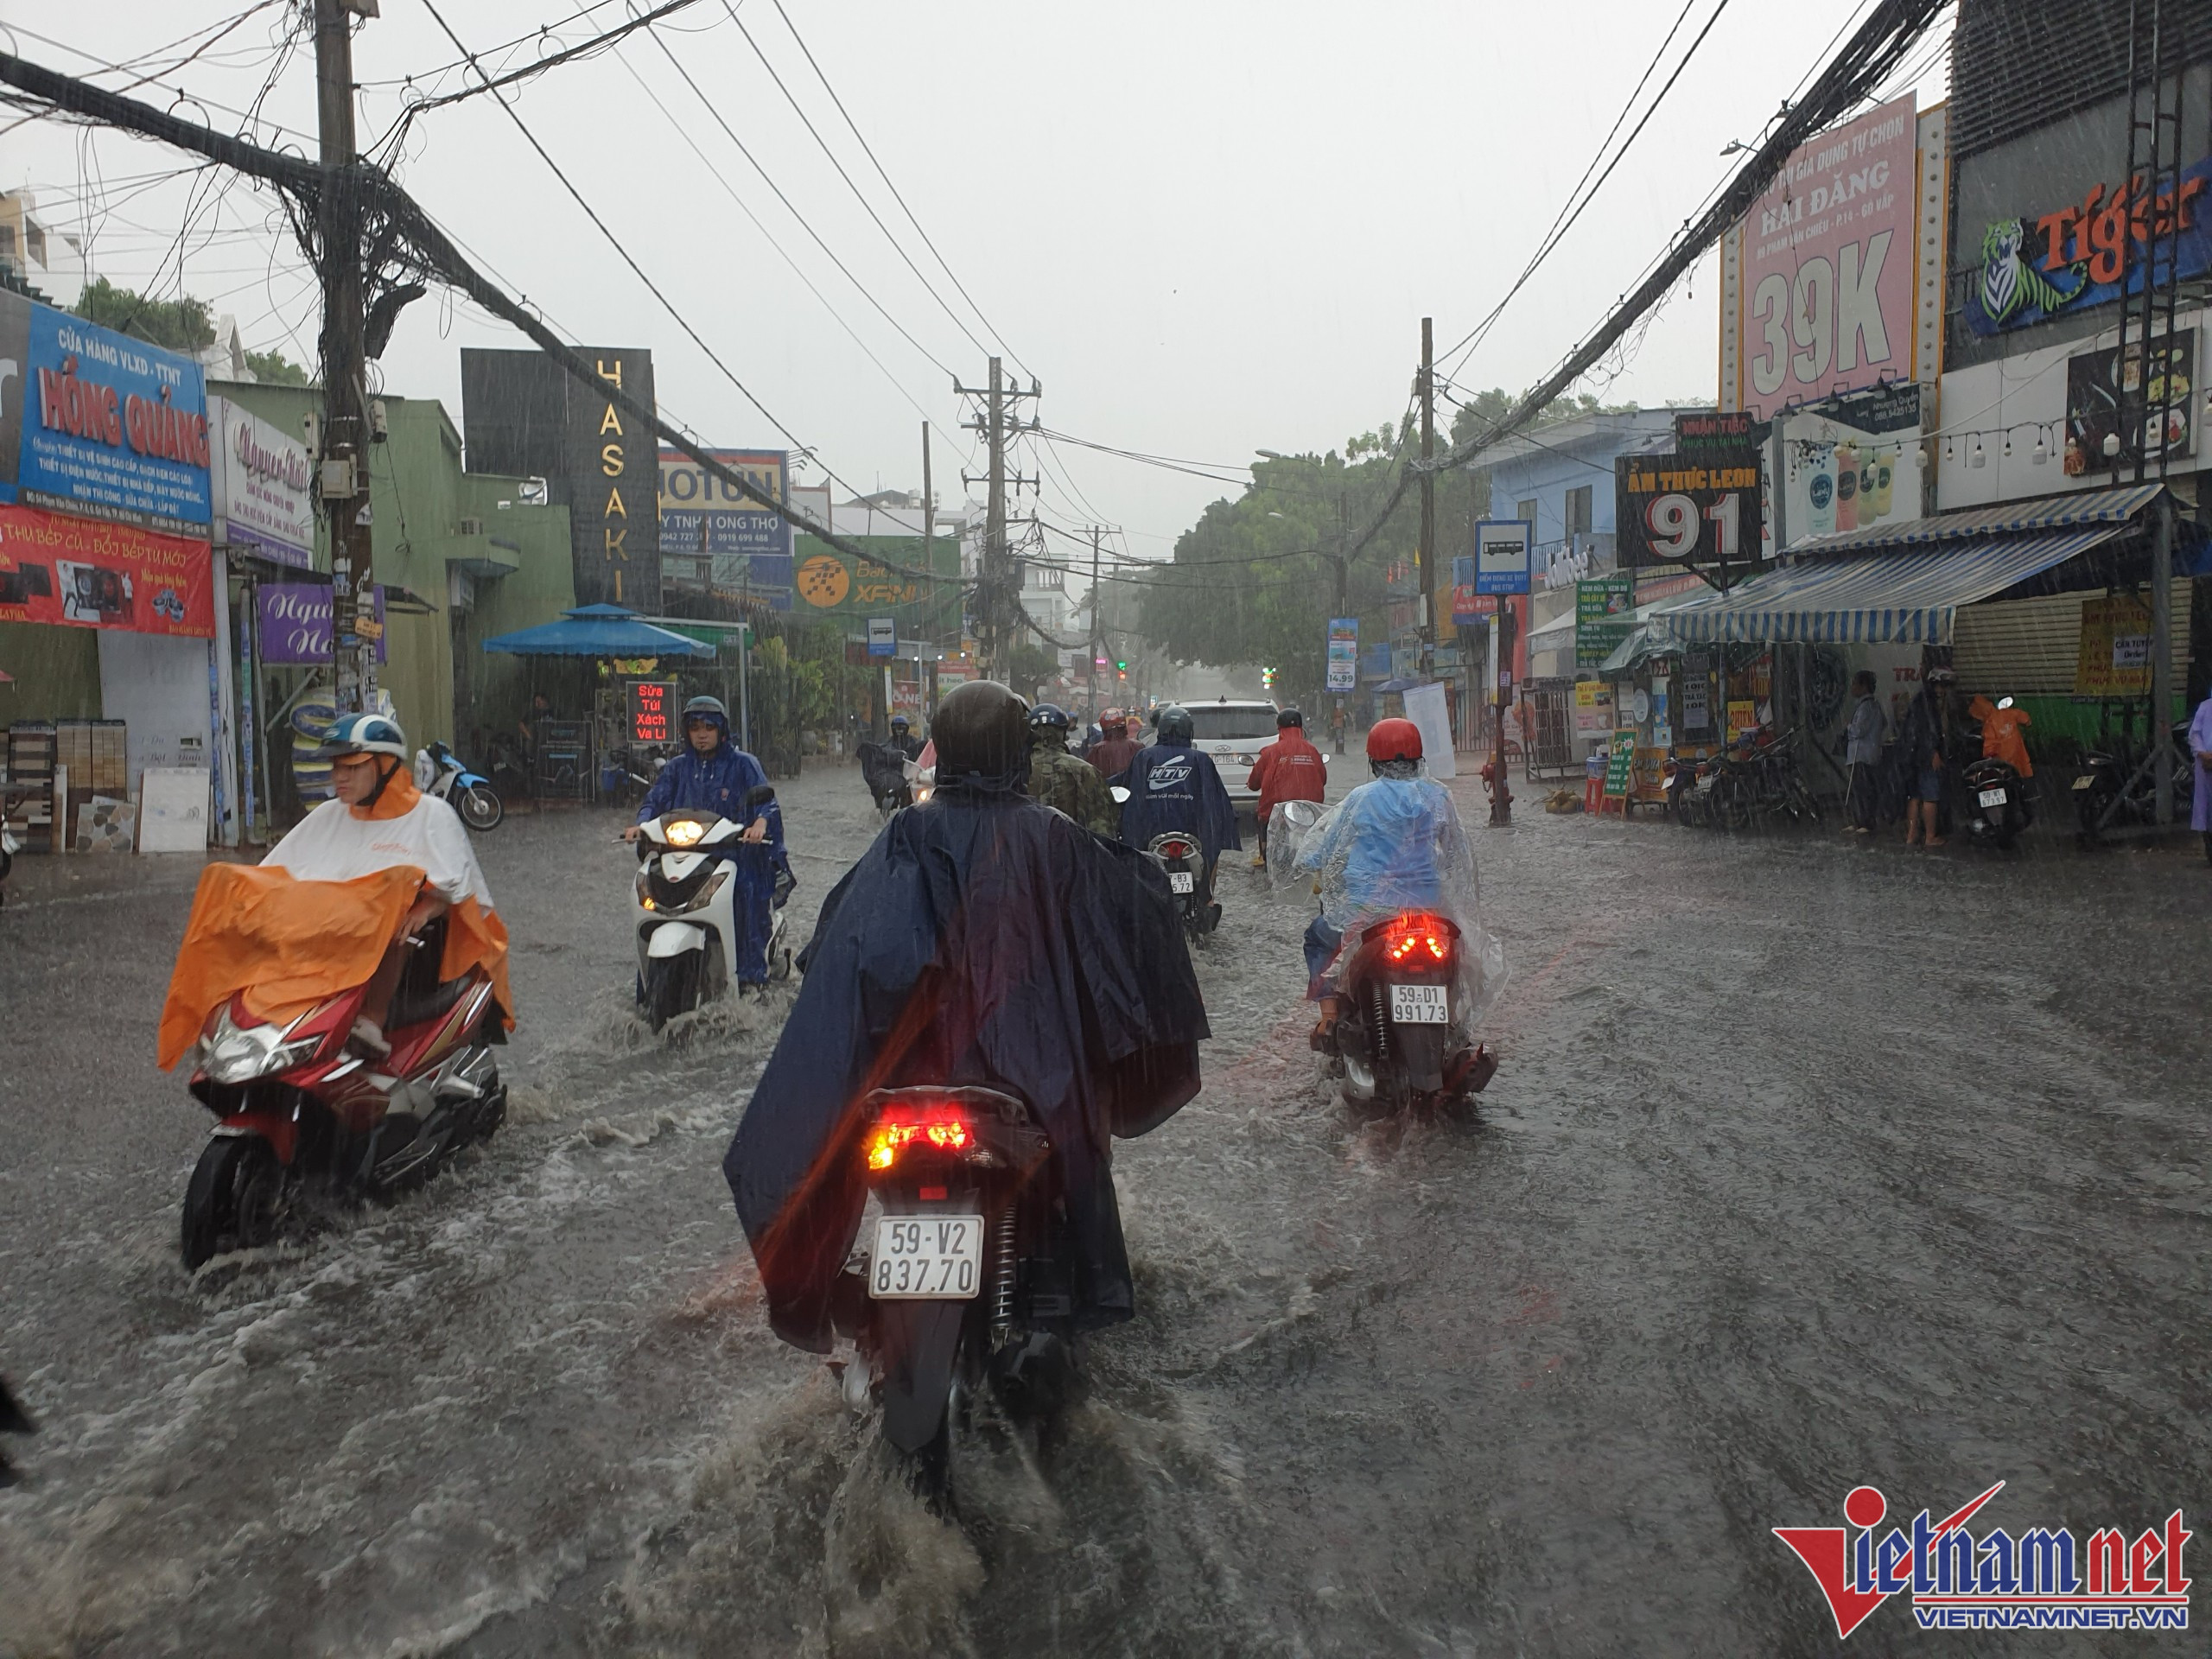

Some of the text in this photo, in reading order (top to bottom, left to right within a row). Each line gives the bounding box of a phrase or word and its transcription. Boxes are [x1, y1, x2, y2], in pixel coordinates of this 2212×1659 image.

[1796, 158, 1815, 180] GIA
[1817, 141, 1848, 172] DỤNG
[1852, 130, 1868, 157] TỰ
[1870, 114, 1904, 145] CHỌN
[1809, 160, 1891, 216] ĐĂNG
[2036, 175, 2203, 284] Tiger
[1751, 228, 1895, 396] 39K
[58, 326, 181, 386] CỬA HÀNG VLXD TTNT
[597, 359, 629, 602] HASAKI
[1659, 466, 1707, 495] THỰC
[1709, 467, 1757, 489] LEON
[3, 523, 34, 543] THU
[37, 523, 63, 546] BẾP
[66, 531, 83, 552] CŨ
[680, 532, 693, 541] 727
[717, 533, 735, 542] 0919
[754, 534, 769, 543] 488
[716, 518, 747, 530] ONG
[751, 516, 778, 532] THỢ
[1645, 493, 1740, 558] 91
[639, 684, 664, 696] Sửa
[636, 714, 665, 726] Xách
[637, 728, 666, 740] Va Li
[1148, 766, 1192, 782] HTV
[1169, 874, 1187, 882] 7-B3
[1173, 883, 1191, 892] 5.72
[1399, 987, 1439, 1003] 59-D1
[1395, 1006, 1446, 1021] 991.73
[891, 1223, 966, 1255] 59-V2
[877, 1259, 973, 1292] 837.70
